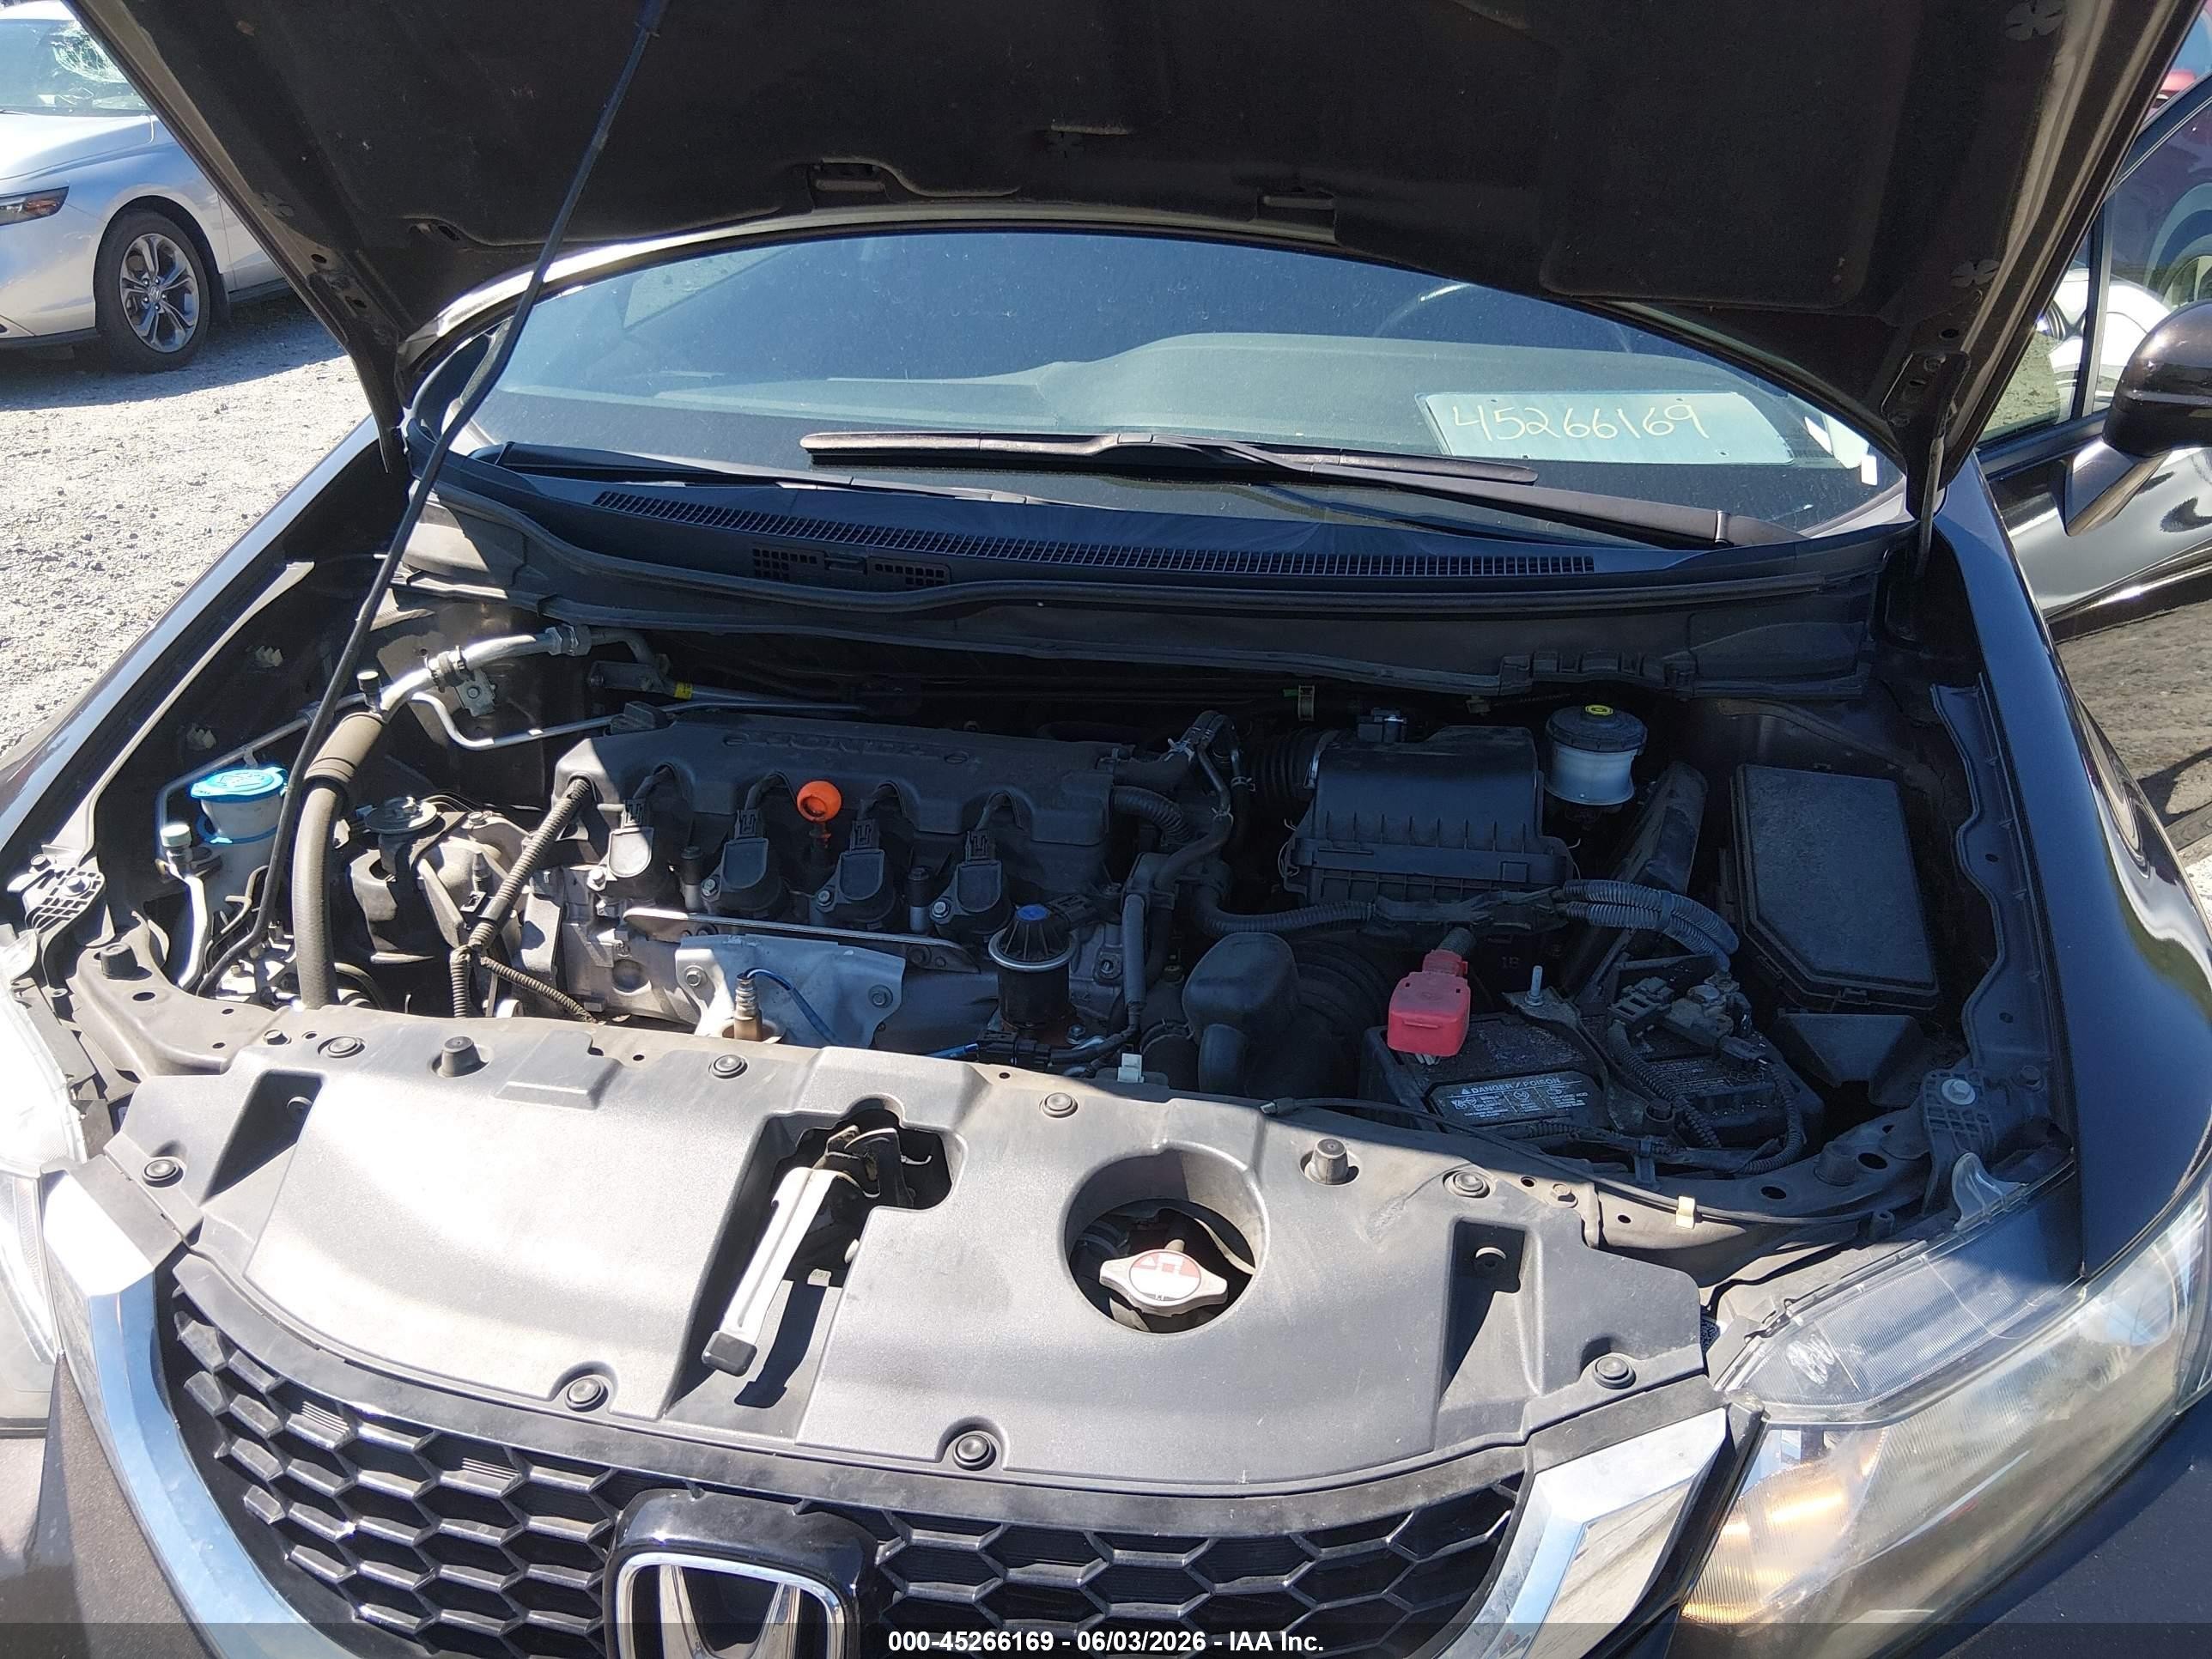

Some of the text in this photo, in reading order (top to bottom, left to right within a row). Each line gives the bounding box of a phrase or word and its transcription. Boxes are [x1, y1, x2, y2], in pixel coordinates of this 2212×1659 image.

[1452, 404, 1711, 441] 45266169
[1471, 1083, 1513, 1094] DANGER
[1523, 1078, 1561, 1087] POISON
